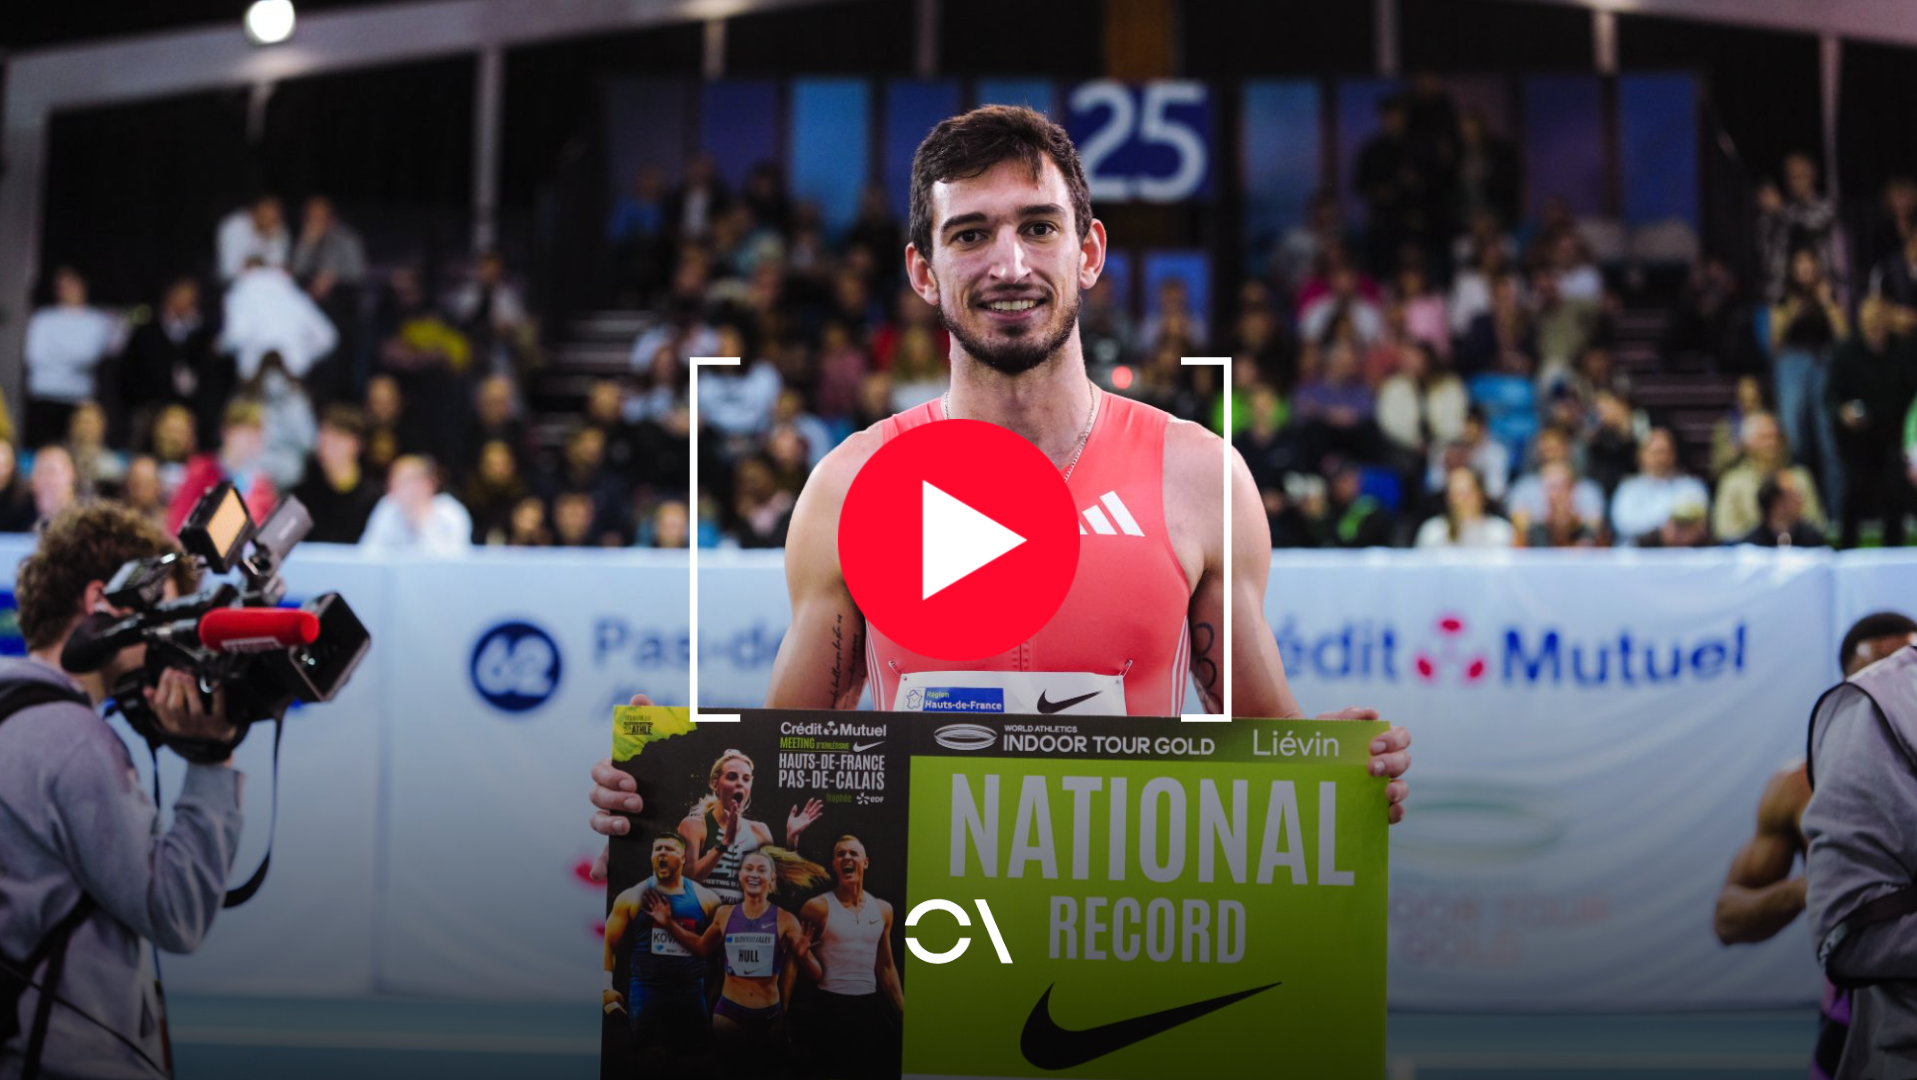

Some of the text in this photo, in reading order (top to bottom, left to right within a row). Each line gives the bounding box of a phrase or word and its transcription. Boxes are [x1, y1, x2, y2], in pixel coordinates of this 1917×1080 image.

[1070, 79, 1208, 203] 25
[1500, 622, 1748, 688] Mutuel
[926, 690, 950, 699] Région
[924, 700, 1003, 710] Hauts-de-France
[780, 721, 887, 737] Crédit Mutuel
[1004, 724, 1078, 734] WORLD ATHLETICS
[779, 737, 815, 749] MEETING
[1003, 735, 1216, 756] INDOOR TOUR GOLD
[1252, 728, 1340, 757] Liévin
[778, 752, 886, 771] HAUTS-DE-FRANCE
[778, 769, 885, 791] PAS-DE-CALAIS
[949, 773, 1356, 887] NATIONAL
[653, 932, 677, 944] KOV
[1048, 895, 1248, 964] RECORD
[738, 949, 760, 963] HULL
